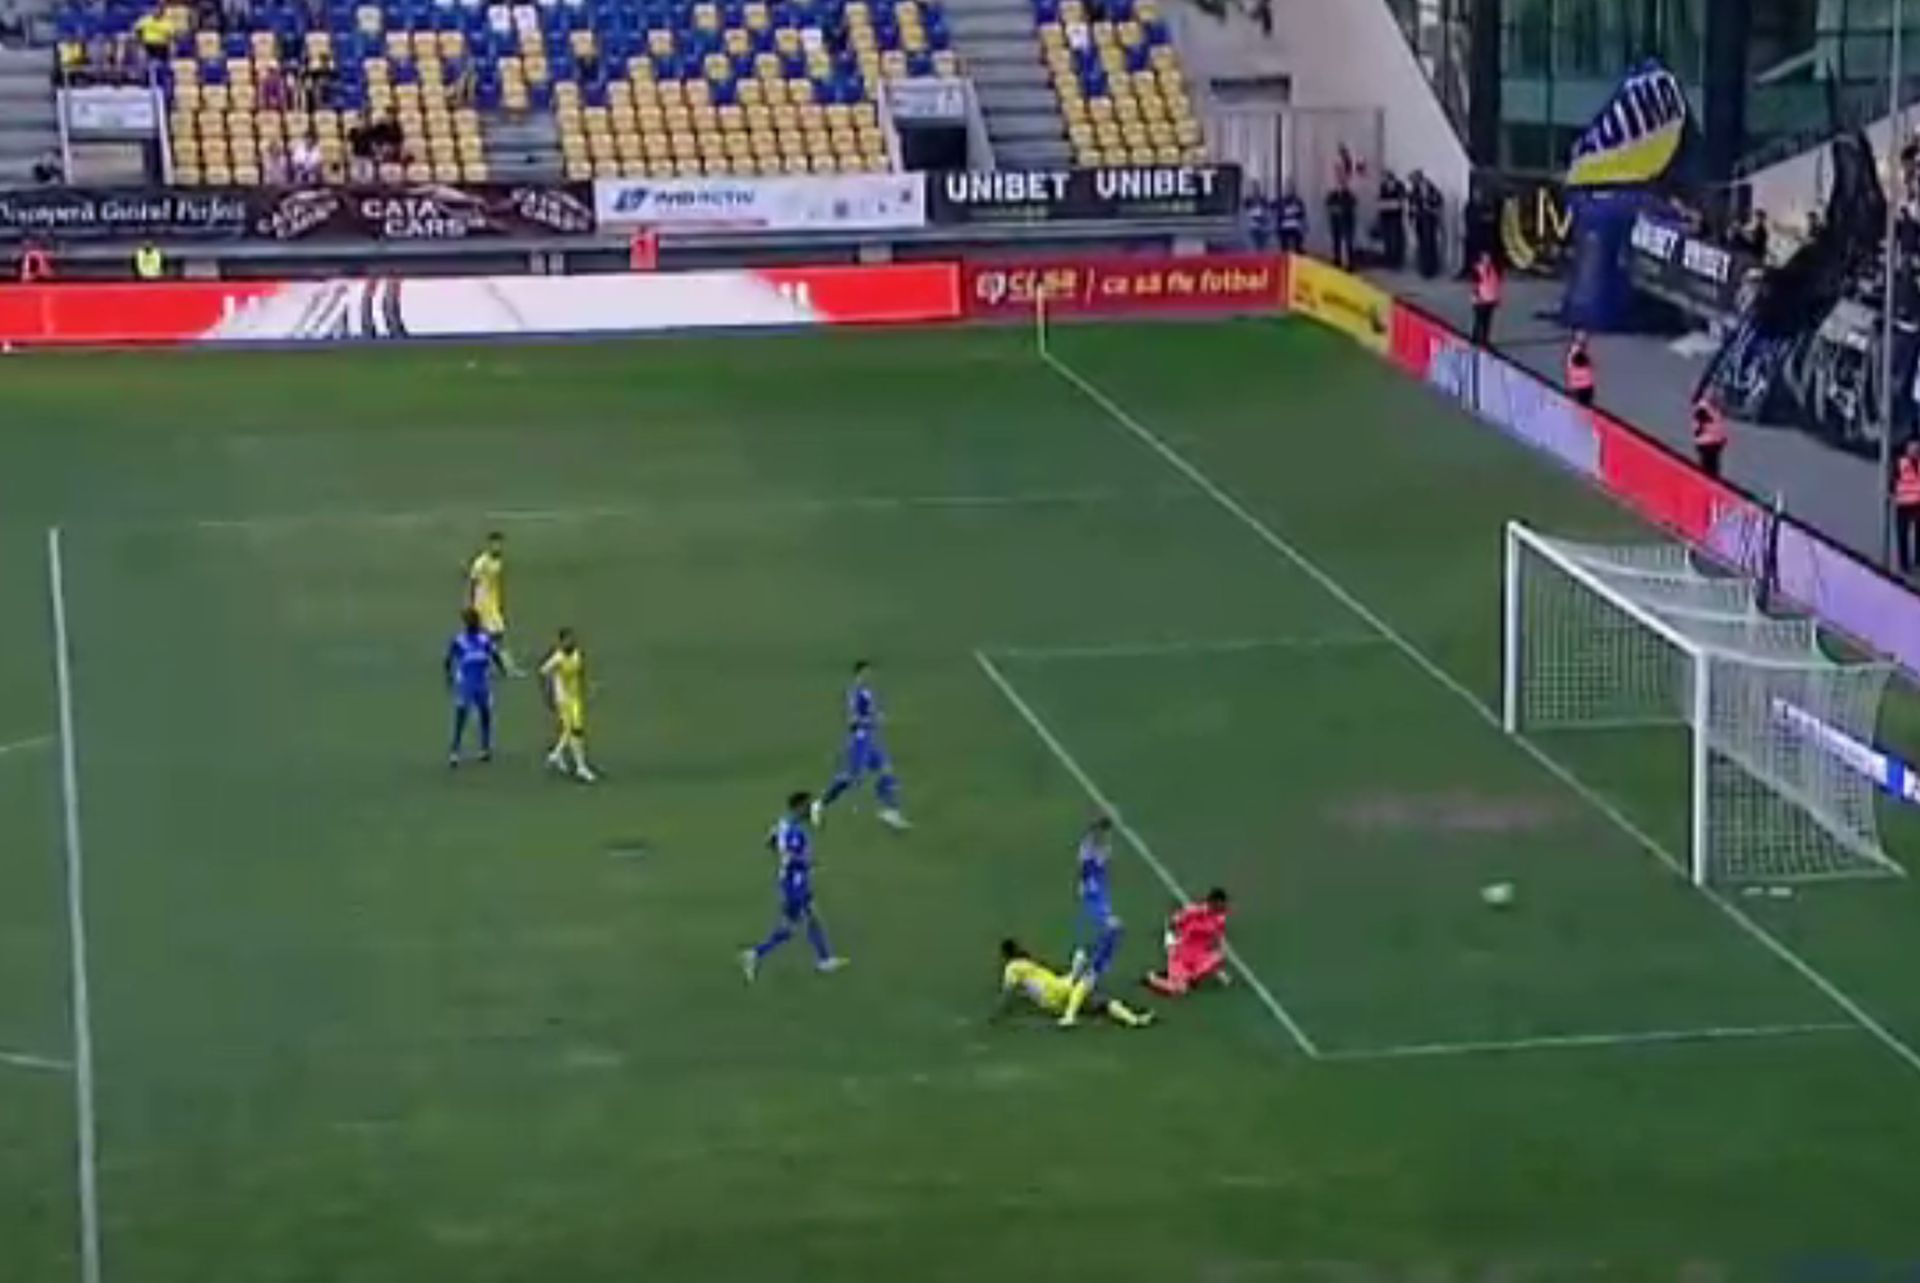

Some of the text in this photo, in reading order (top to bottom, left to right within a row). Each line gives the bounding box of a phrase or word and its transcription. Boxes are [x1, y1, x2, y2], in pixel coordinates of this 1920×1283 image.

[948, 167, 1217, 201] UNIBET UNIBET
[361, 198, 438, 218] CATA
[385, 218, 467, 238] CARS
[1103, 276, 1127, 294] ca
[1201, 268, 1269, 292] fotbal
